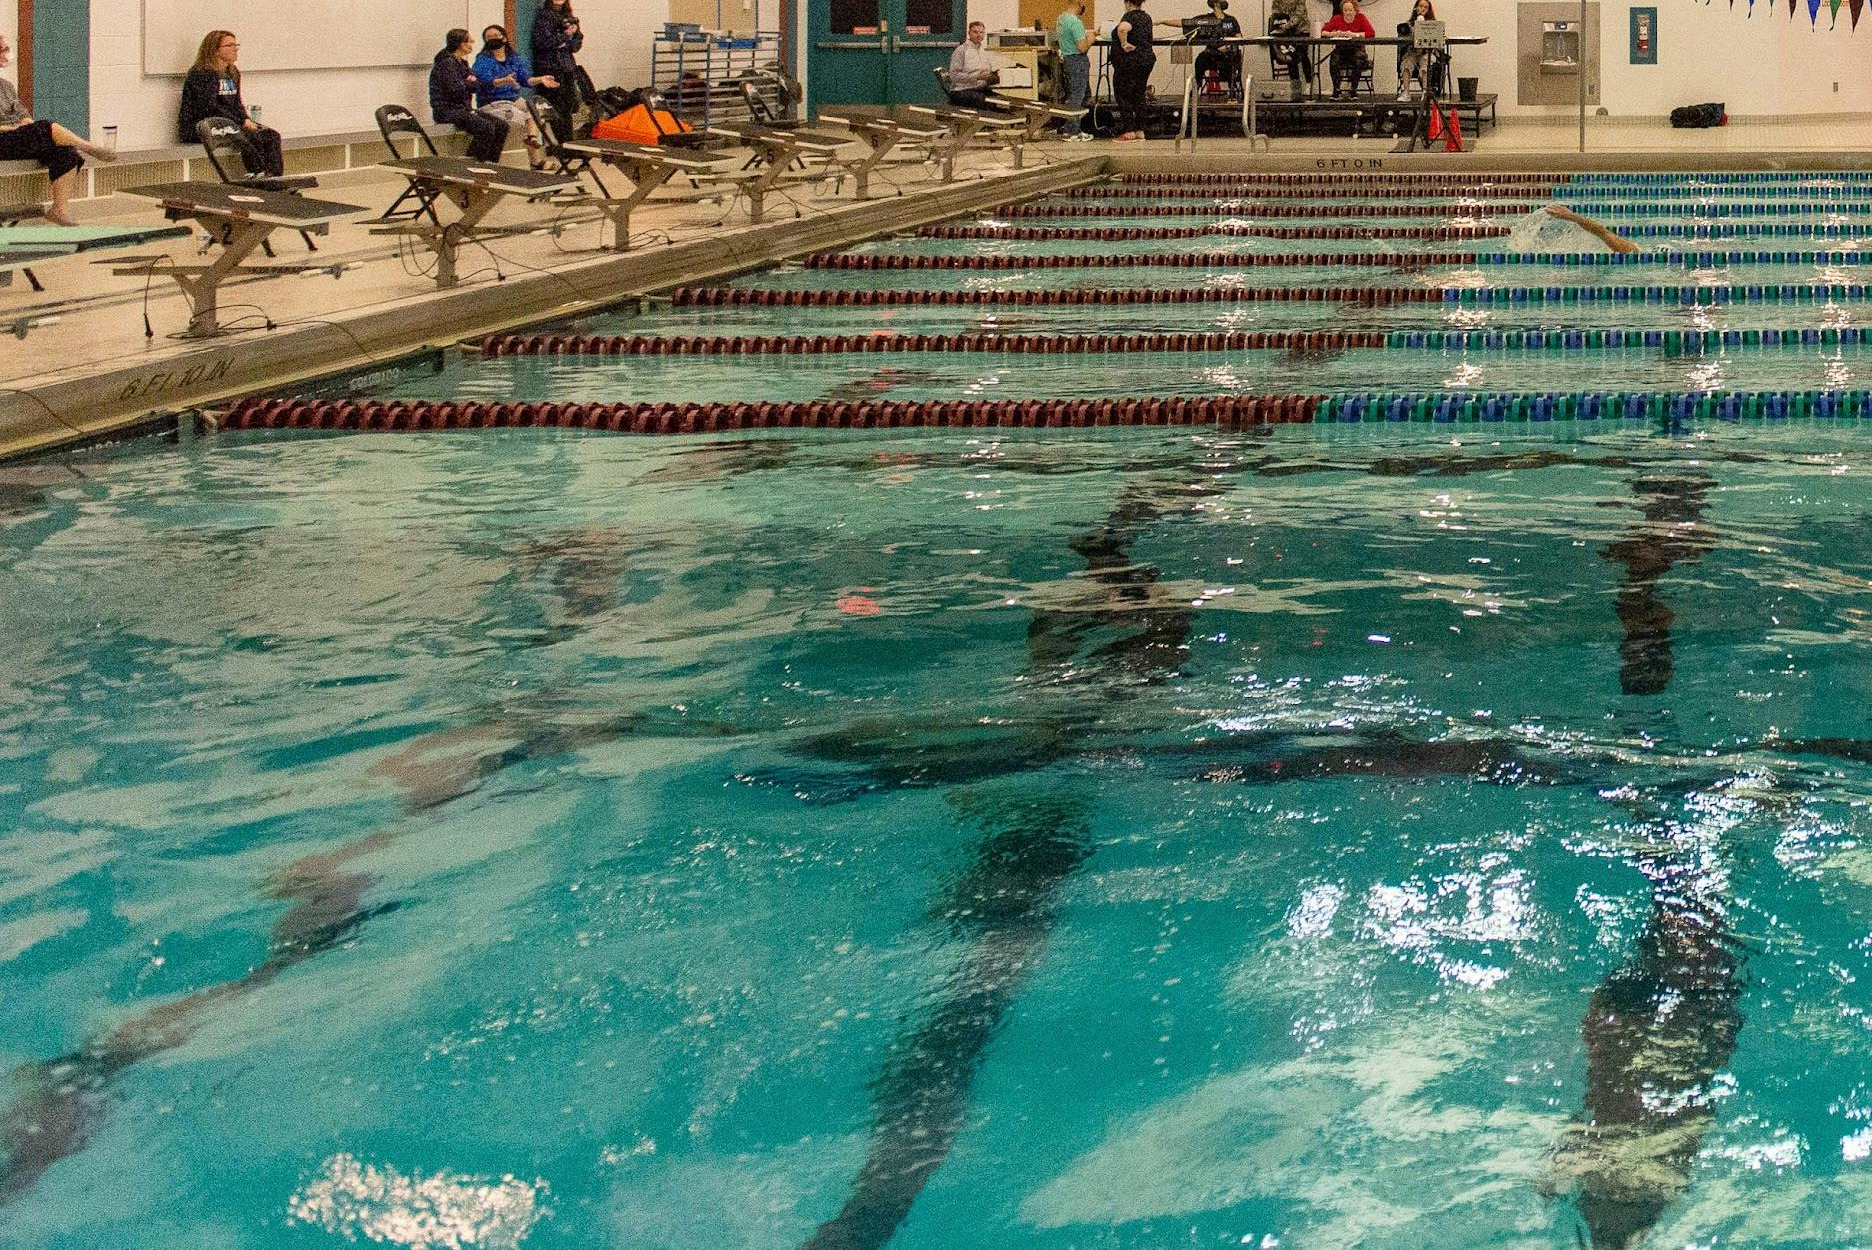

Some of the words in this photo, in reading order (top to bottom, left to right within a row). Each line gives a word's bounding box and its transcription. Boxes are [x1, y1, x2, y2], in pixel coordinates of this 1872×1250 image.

[1316, 159, 1325, 169] 6
[1330, 158, 1350, 169] FT
[1368, 158, 1382, 168] IN
[460, 189, 470, 209] 3
[222, 222, 233, 245] 2
[119, 376, 139, 400] 6
[141, 372, 174, 397] FT
[177, 364, 202, 388] 10
[204, 357, 235, 383] IN
